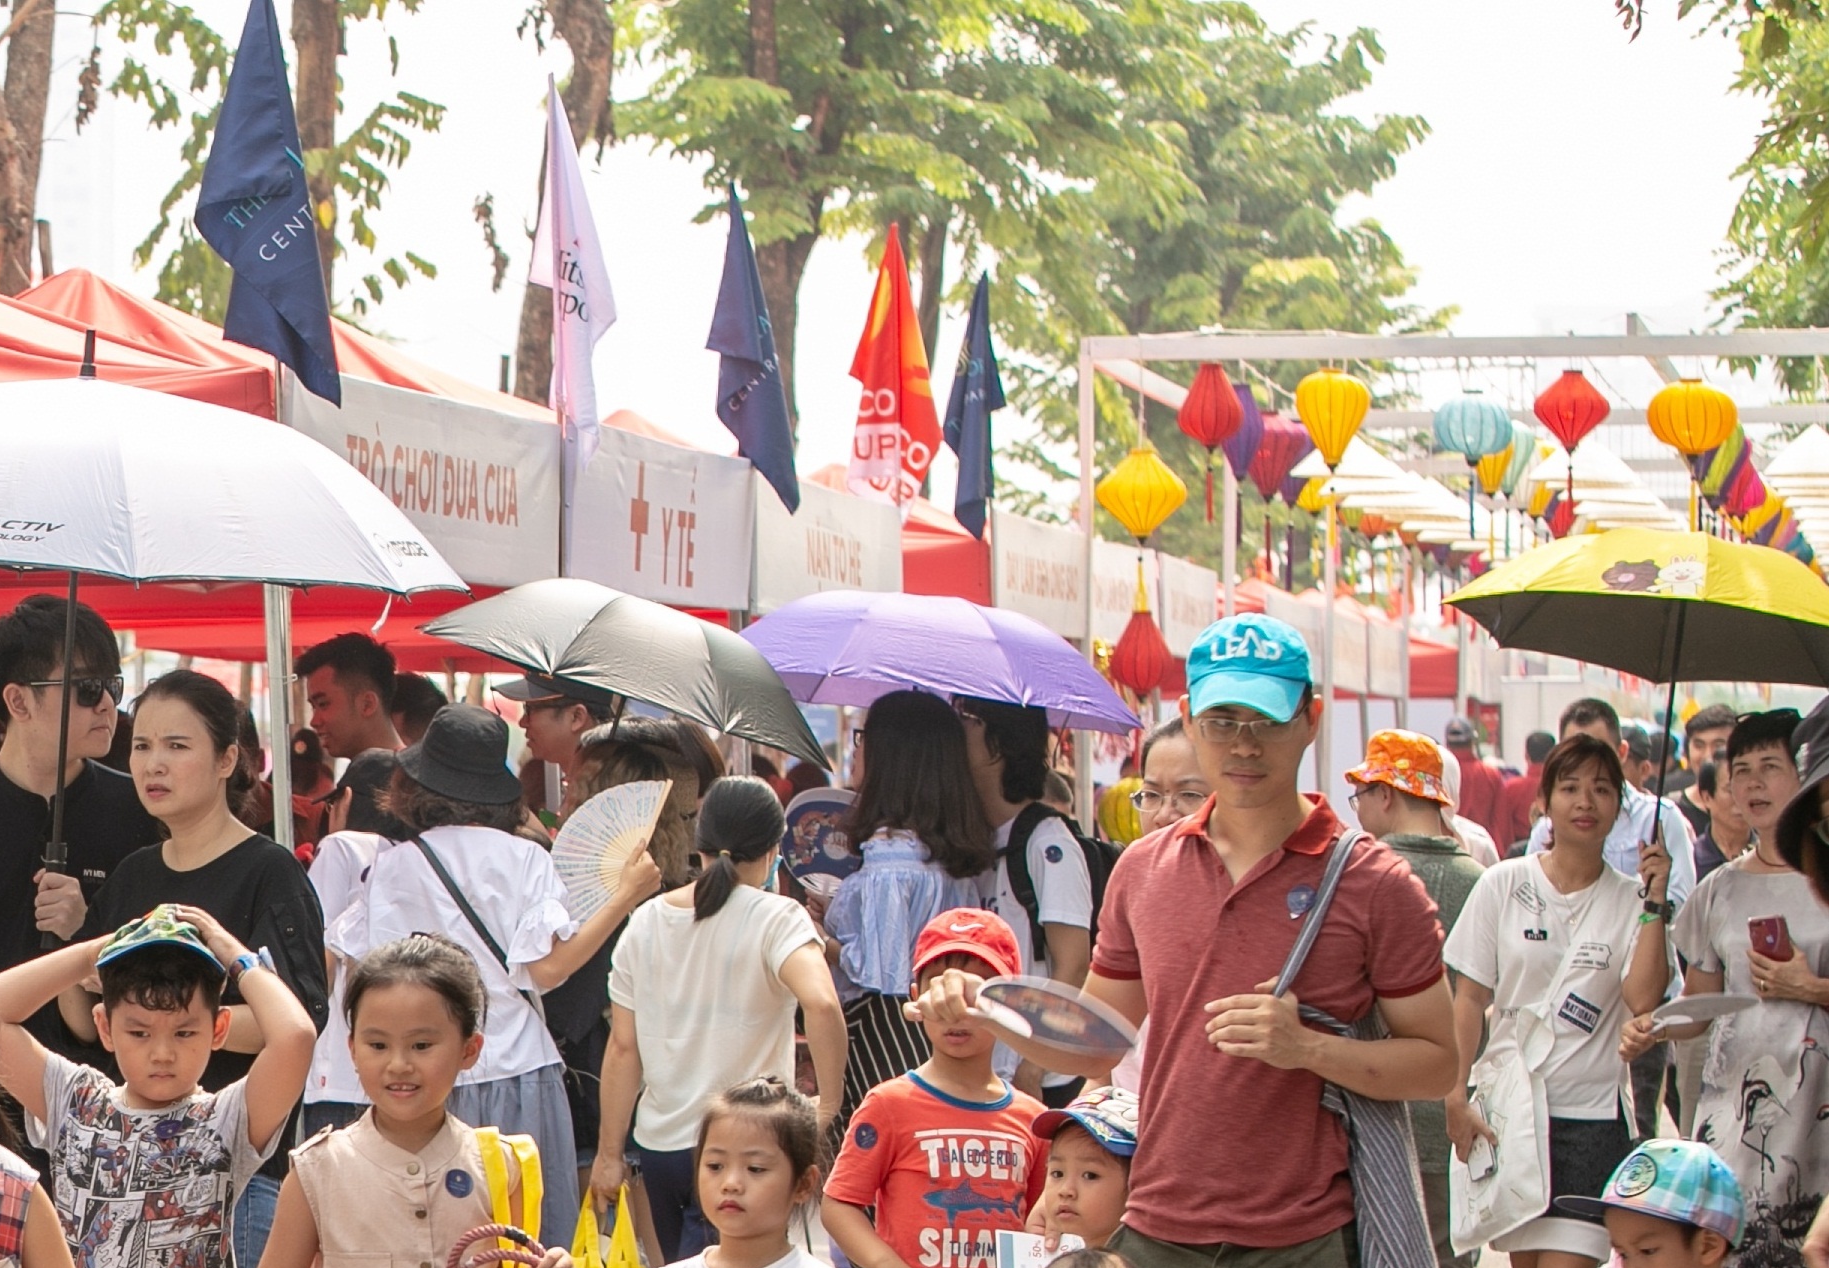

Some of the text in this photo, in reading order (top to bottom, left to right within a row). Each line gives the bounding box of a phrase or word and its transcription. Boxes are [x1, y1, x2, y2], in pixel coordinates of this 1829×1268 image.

[259, 203, 313, 261] CENT
[858, 387, 896, 418] CO
[854, 434, 897, 460] UP
[484, 463, 518, 527] CUA
[661, 466, 696, 588] Y TẾ
[1210, 627, 1283, 661] LEAD
[1564, 999, 1597, 1026] NATIONAL
